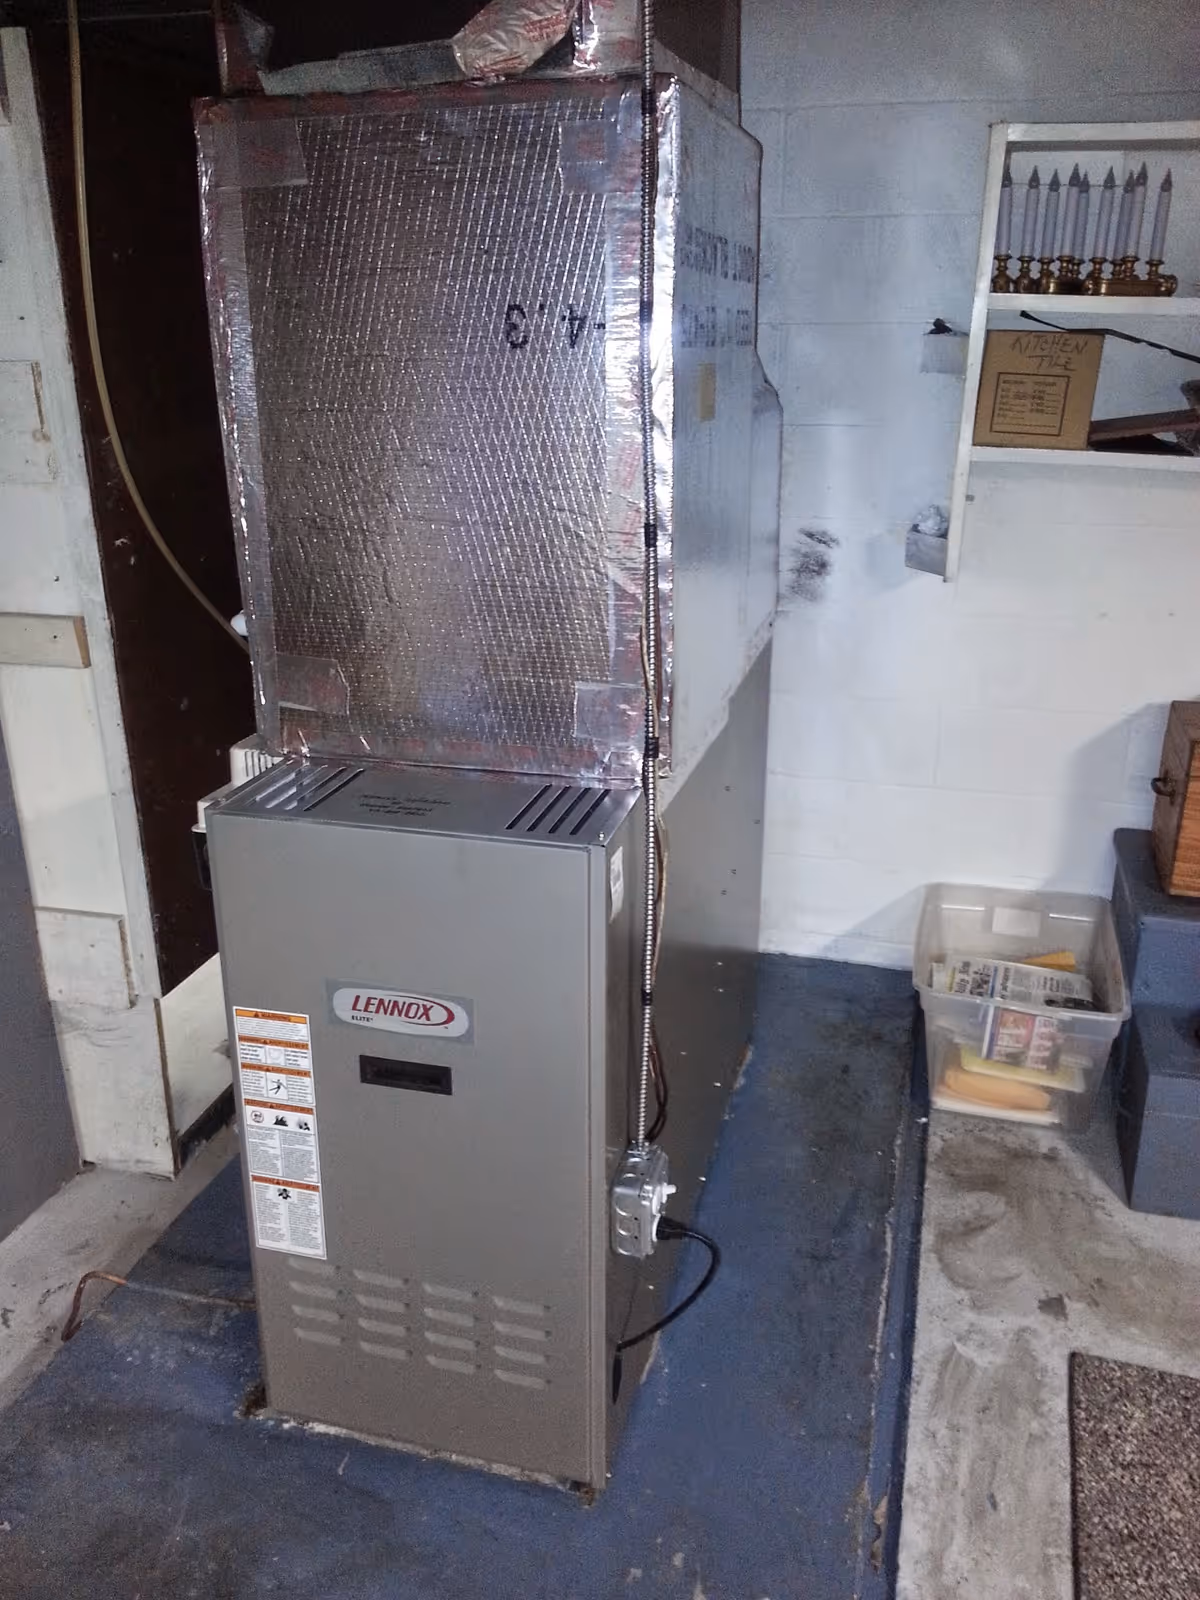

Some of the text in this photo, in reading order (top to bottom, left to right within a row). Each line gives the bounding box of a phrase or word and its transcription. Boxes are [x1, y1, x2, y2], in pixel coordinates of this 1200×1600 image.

[1010, 332, 1088, 354] KITCHEN
[1026, 354, 1077, 372] TILE
[351, 994, 434, 1022] LENNOX
